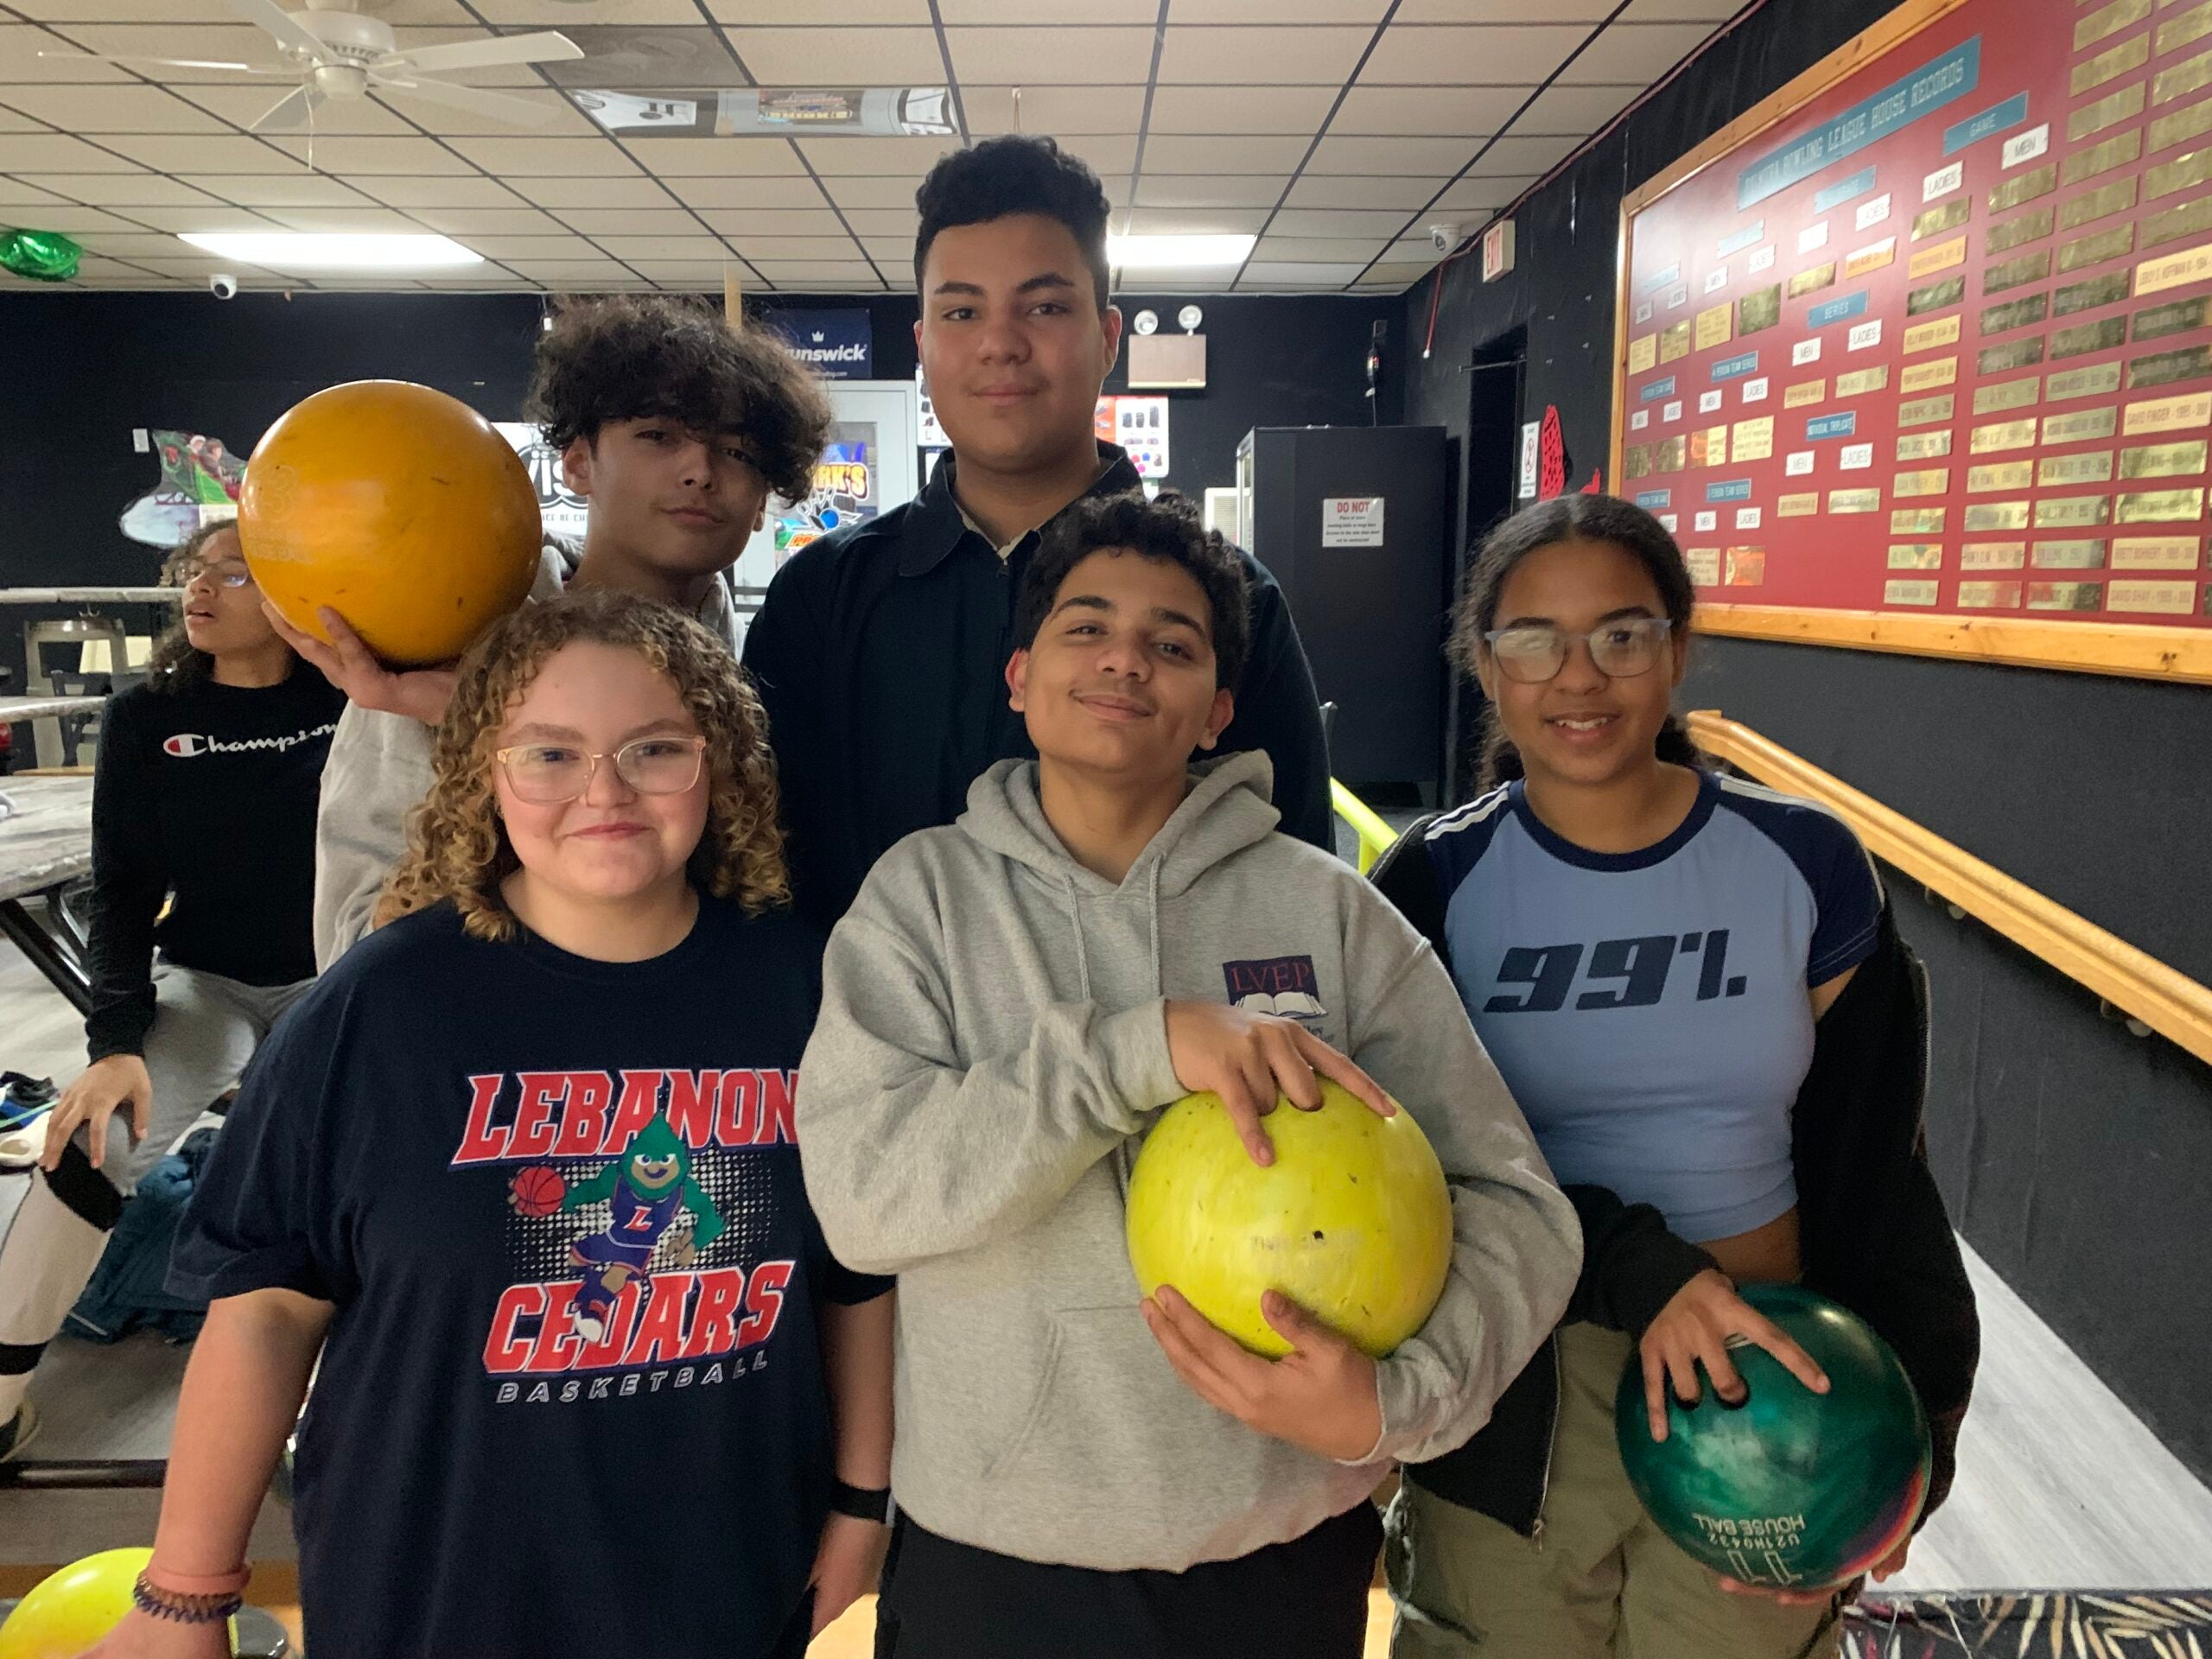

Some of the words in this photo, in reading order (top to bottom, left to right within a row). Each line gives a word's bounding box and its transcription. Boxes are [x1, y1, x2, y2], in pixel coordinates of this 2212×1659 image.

[1783, 137, 1823, 175] BOWLING
[1827, 112, 1866, 152] LEAGUE
[1871, 90, 1907, 130] HOUSE
[1910, 57, 1965, 108] RECORDS
[1970, 113, 1997, 137] GAME
[2015, 137, 2036, 156] MEN
[1928, 172, 1957, 195] LADIES
[1824, 302, 1849, 321] SERIES
[1853, 327, 1877, 345] LADIES
[784, 344, 867, 361] runswick
[1800, 345, 1814, 359] MEN
[1745, 385, 1764, 397] LADIES
[1705, 396, 1716, 407] MEN
[1793, 457, 1808, 469] MEN
[1843, 450, 1868, 465] LADIES
[1337, 501, 1349, 513] DO
[1351, 501, 1370, 513] NOT
[1700, 518, 1711, 526] MEN
[1739, 512, 1758, 524] LADIES
[1230, 962, 1311, 993] LVEP
[450, 1068, 799, 1167] LEBANON
[623, 1205, 654, 1231] L
[481, 1260, 796, 1374] CEDARS
[495, 1350, 769, 1404] BASKETBALL
[1691, 1513, 1738, 1536] BALL
[1741, 1514, 1806, 1536] HOUSE
